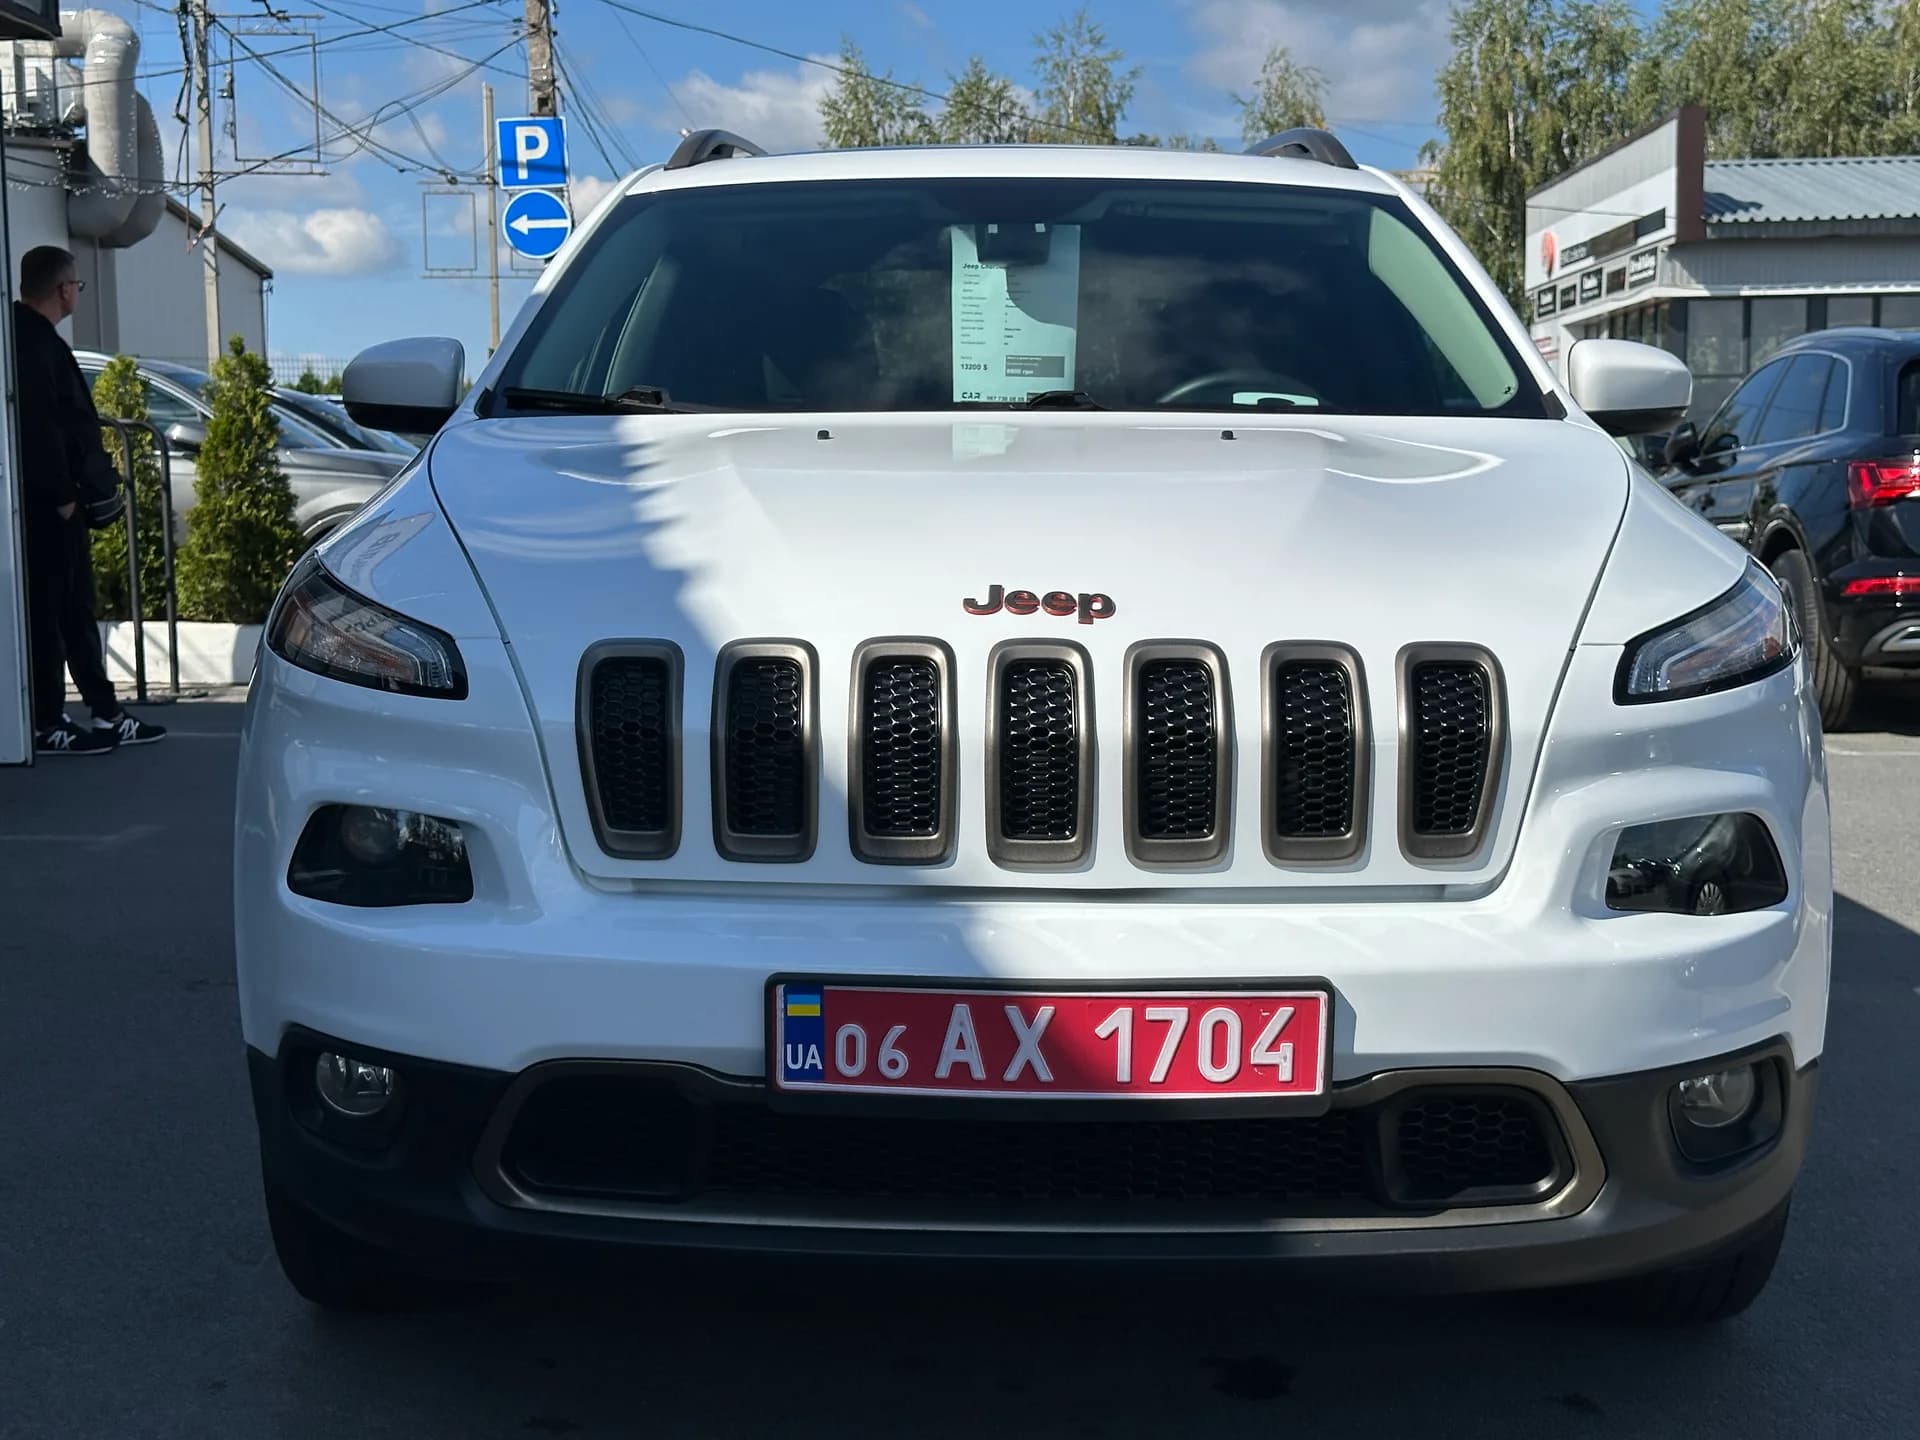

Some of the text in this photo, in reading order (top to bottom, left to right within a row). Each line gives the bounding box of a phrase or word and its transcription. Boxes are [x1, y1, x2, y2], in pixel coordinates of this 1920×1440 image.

[515, 126, 549, 180] P
[962, 585, 1117, 625] Jeep
[785, 1003, 1296, 1084] UA 06 AX 1704
